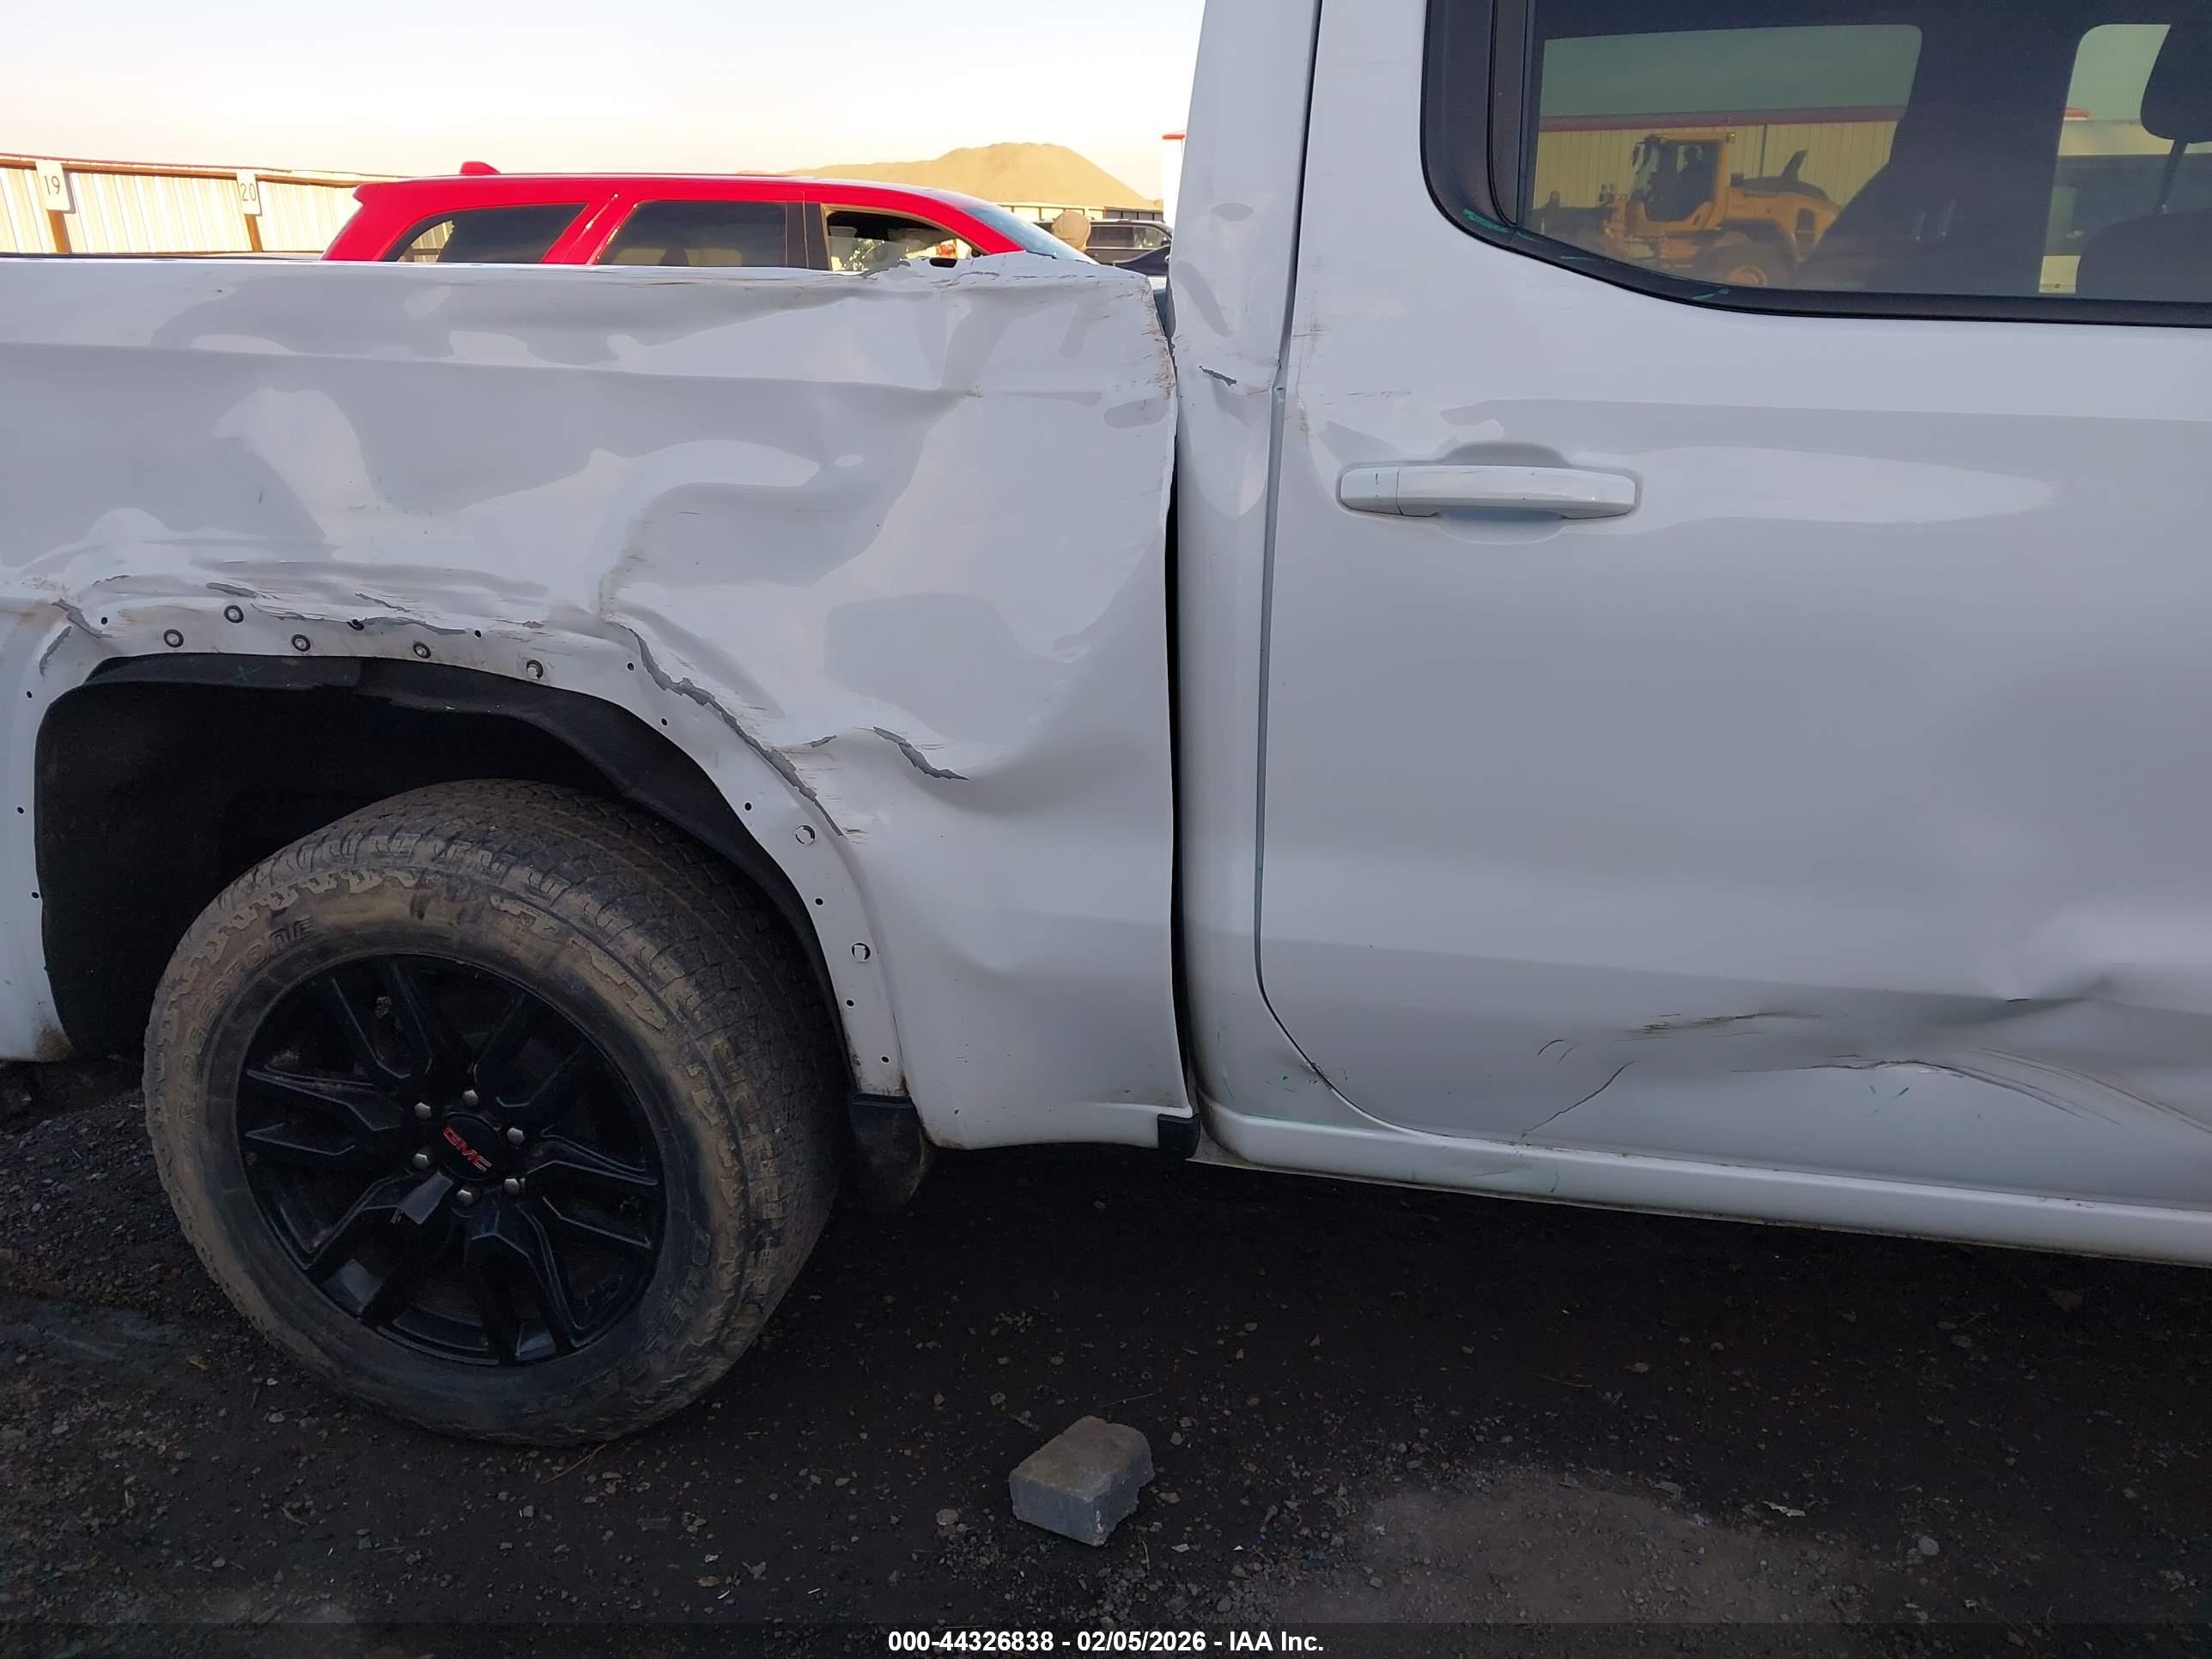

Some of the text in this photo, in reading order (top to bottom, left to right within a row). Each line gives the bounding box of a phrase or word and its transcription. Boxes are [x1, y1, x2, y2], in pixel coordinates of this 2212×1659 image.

[44, 174, 61, 196] 19
[240, 182, 257, 202] 20
[442, 1127, 493, 1173] GMC
